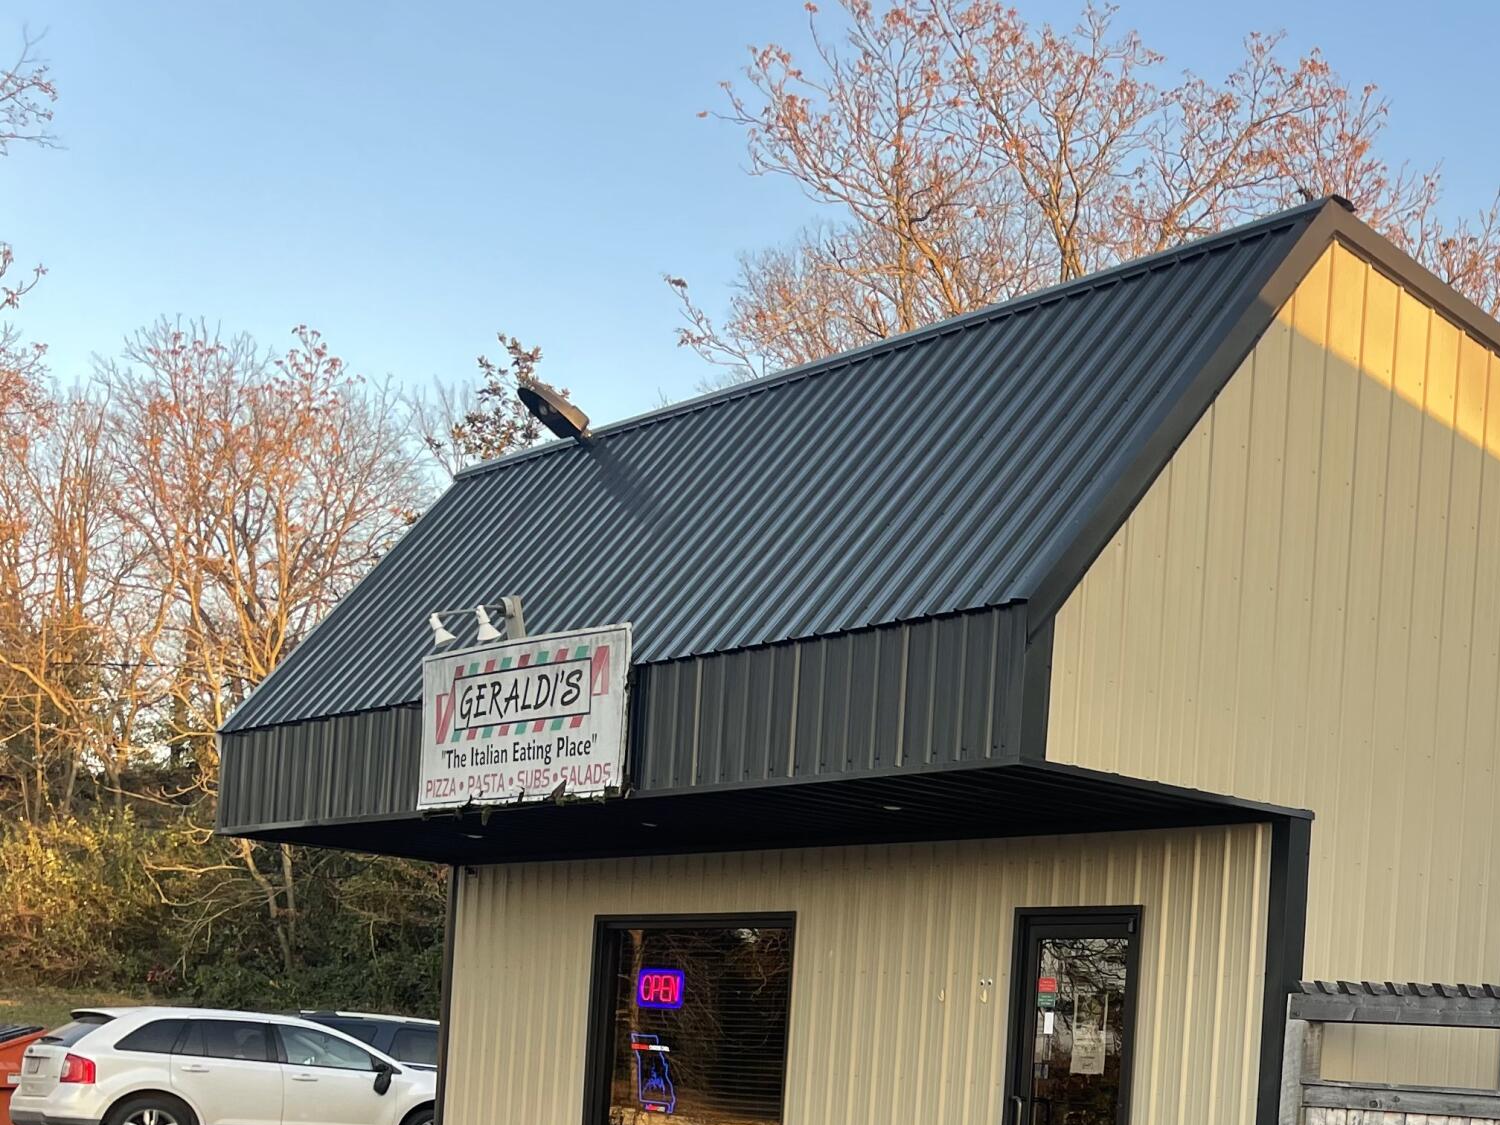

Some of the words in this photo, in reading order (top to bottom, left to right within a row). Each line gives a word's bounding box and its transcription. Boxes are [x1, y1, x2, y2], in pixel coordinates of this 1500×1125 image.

[460, 669, 583, 728] GERALDI'S
[471, 744, 507, 766] Italian
[513, 739, 552, 764] Eating
[557, 734, 598, 758] Place"
[426, 779, 456, 798] PIZZA
[468, 774, 505, 793] PASTA
[517, 769, 550, 789] SUBS
[560, 763, 611, 785] SALADS
[641, 975, 680, 1002] OPEN
